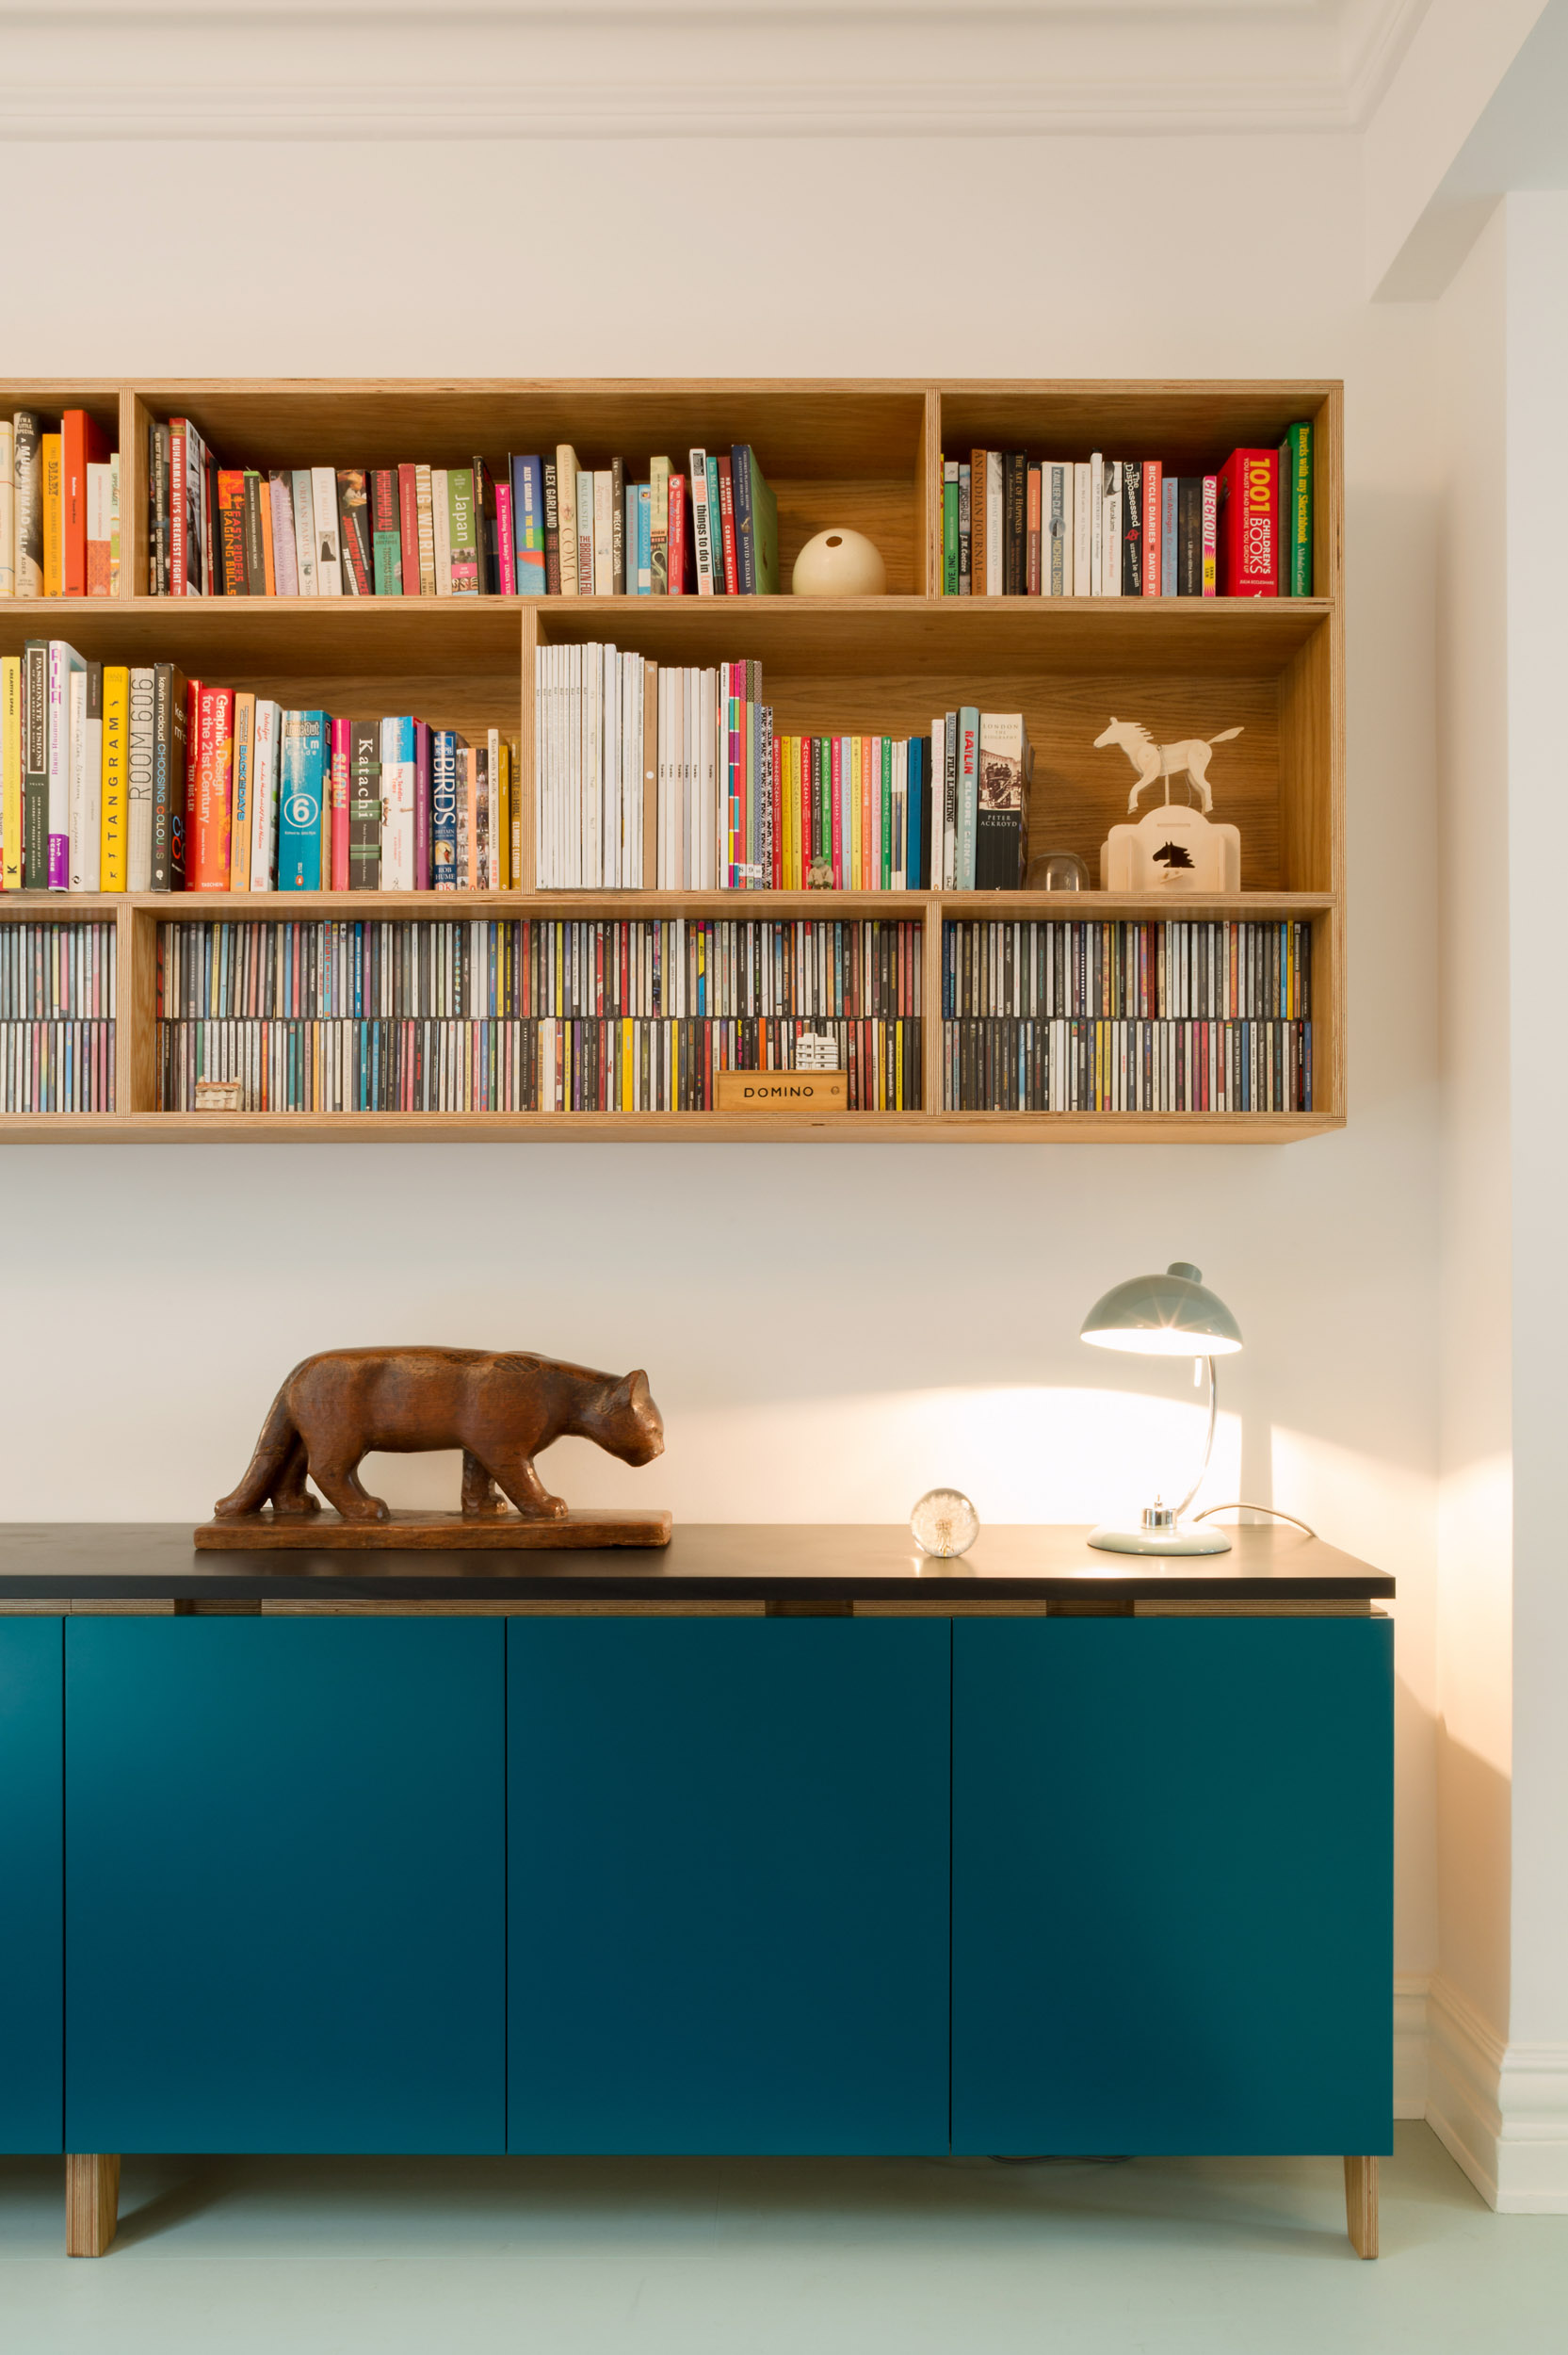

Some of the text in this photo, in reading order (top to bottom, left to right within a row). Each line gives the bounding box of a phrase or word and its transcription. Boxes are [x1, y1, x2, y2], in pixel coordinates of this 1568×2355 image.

[546, 464, 556, 486] ALEX
[725, 477, 731, 486] NO
[974, 451, 984, 468] AN
[1015, 456, 1024, 469] THE
[1015, 471, 1024, 484] ART
[21, 446, 30, 526] MUHAMMAD
[377, 470, 392, 516] MUHAMMAD
[546, 488, 558, 528] GARLAND
[974, 472, 984, 518] INDIAN
[1015, 487, 1024, 497] OF
[1124, 463, 1140, 528] Dispossessed
[1250, 458, 1270, 512] 1001
[1297, 428, 1309, 544] Travels with my Sketchbook
[20, 528, 28, 544] ALI
[378, 518, 392, 530] ALI
[416, 465, 433, 572] KING WORLD
[452, 494, 470, 541] Japan
[697, 505, 707, 535] things
[1015, 499, 1024, 534] HAPPINESS
[1165, 503, 1174, 534] Alvtegen
[1204, 479, 1216, 549] CHECKOUT
[224, 511, 237, 595] RAGING BULLS
[232, 511, 244, 582] EASY RIDERS
[343, 516, 362, 560] JONATHAN
[562, 528, 575, 582] COMA
[699, 538, 708, 548] to
[699, 550, 709, 561] do
[743, 537, 752, 558] DAVID
[974, 519, 984, 575] JOURNAL
[1250, 518, 1263, 574] BOOKS
[1263, 518, 1271, 574] CHILDREN'S
[580, 543, 591, 580] BROOKLYN
[701, 564, 710, 573] in
[1132, 573, 1140, 588] guin
[158, 676, 167, 701] kevin
[129, 678, 154, 801] ROOM 606
[200, 695, 213, 823] for the 21st Century
[215, 695, 229, 795] Graphic Design
[964, 731, 974, 774] RAYLAN
[108, 718, 120, 840] TANGRAM
[156, 744, 166, 803] CHOOSING
[237, 745, 248, 821] BACK DAYS
[359, 739, 373, 819] Katachi
[433, 757, 457, 825] BIRDS
[156, 806, 166, 859] COLOURS
[293, 799, 309, 822] 6
[744, 1086, 814, 1097] DOMINO
